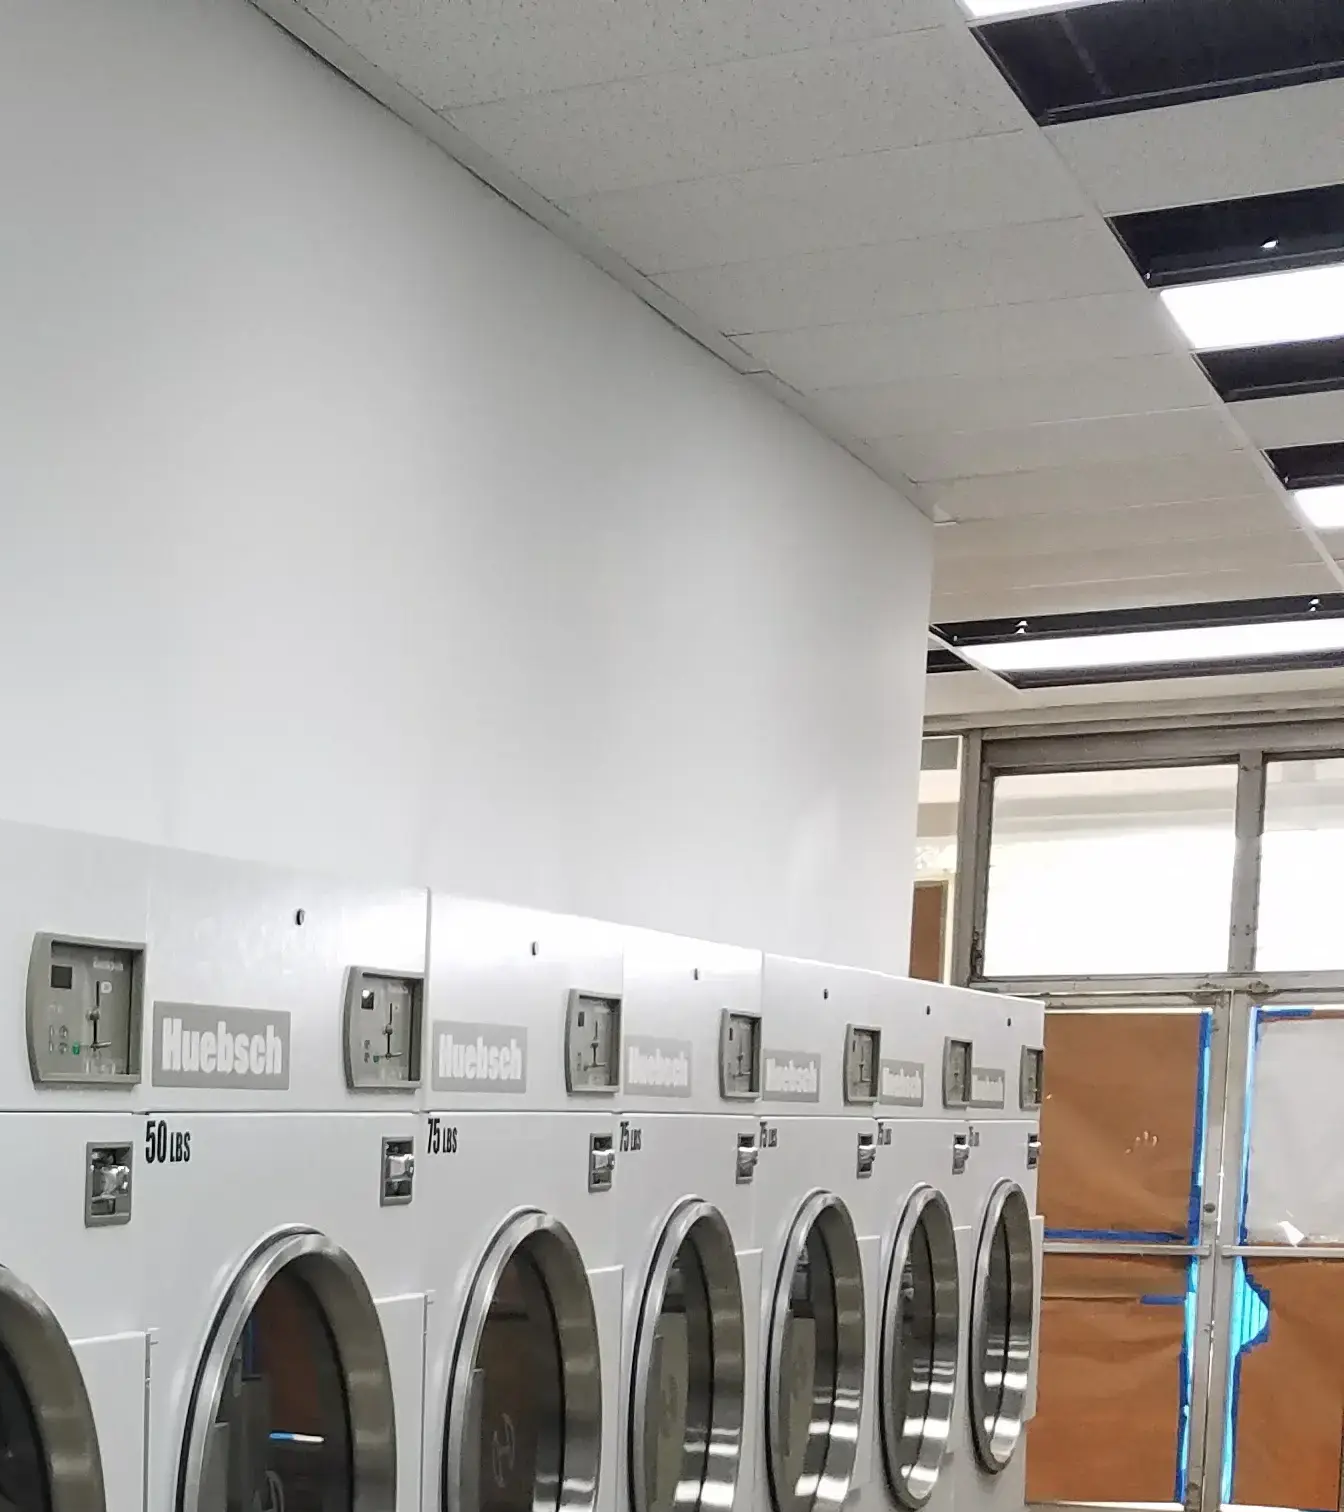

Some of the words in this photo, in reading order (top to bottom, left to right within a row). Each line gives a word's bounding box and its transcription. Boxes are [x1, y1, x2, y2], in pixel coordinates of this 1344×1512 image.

[162, 1017, 282, 1076] Huebsch
[438, 1033, 523, 1081] Huebsch
[145, 1120, 168, 1164] 50
[169, 1131, 191, 1163] LBS
[427, 1118, 440, 1154] 75
[442, 1126, 458, 1153] LBS
